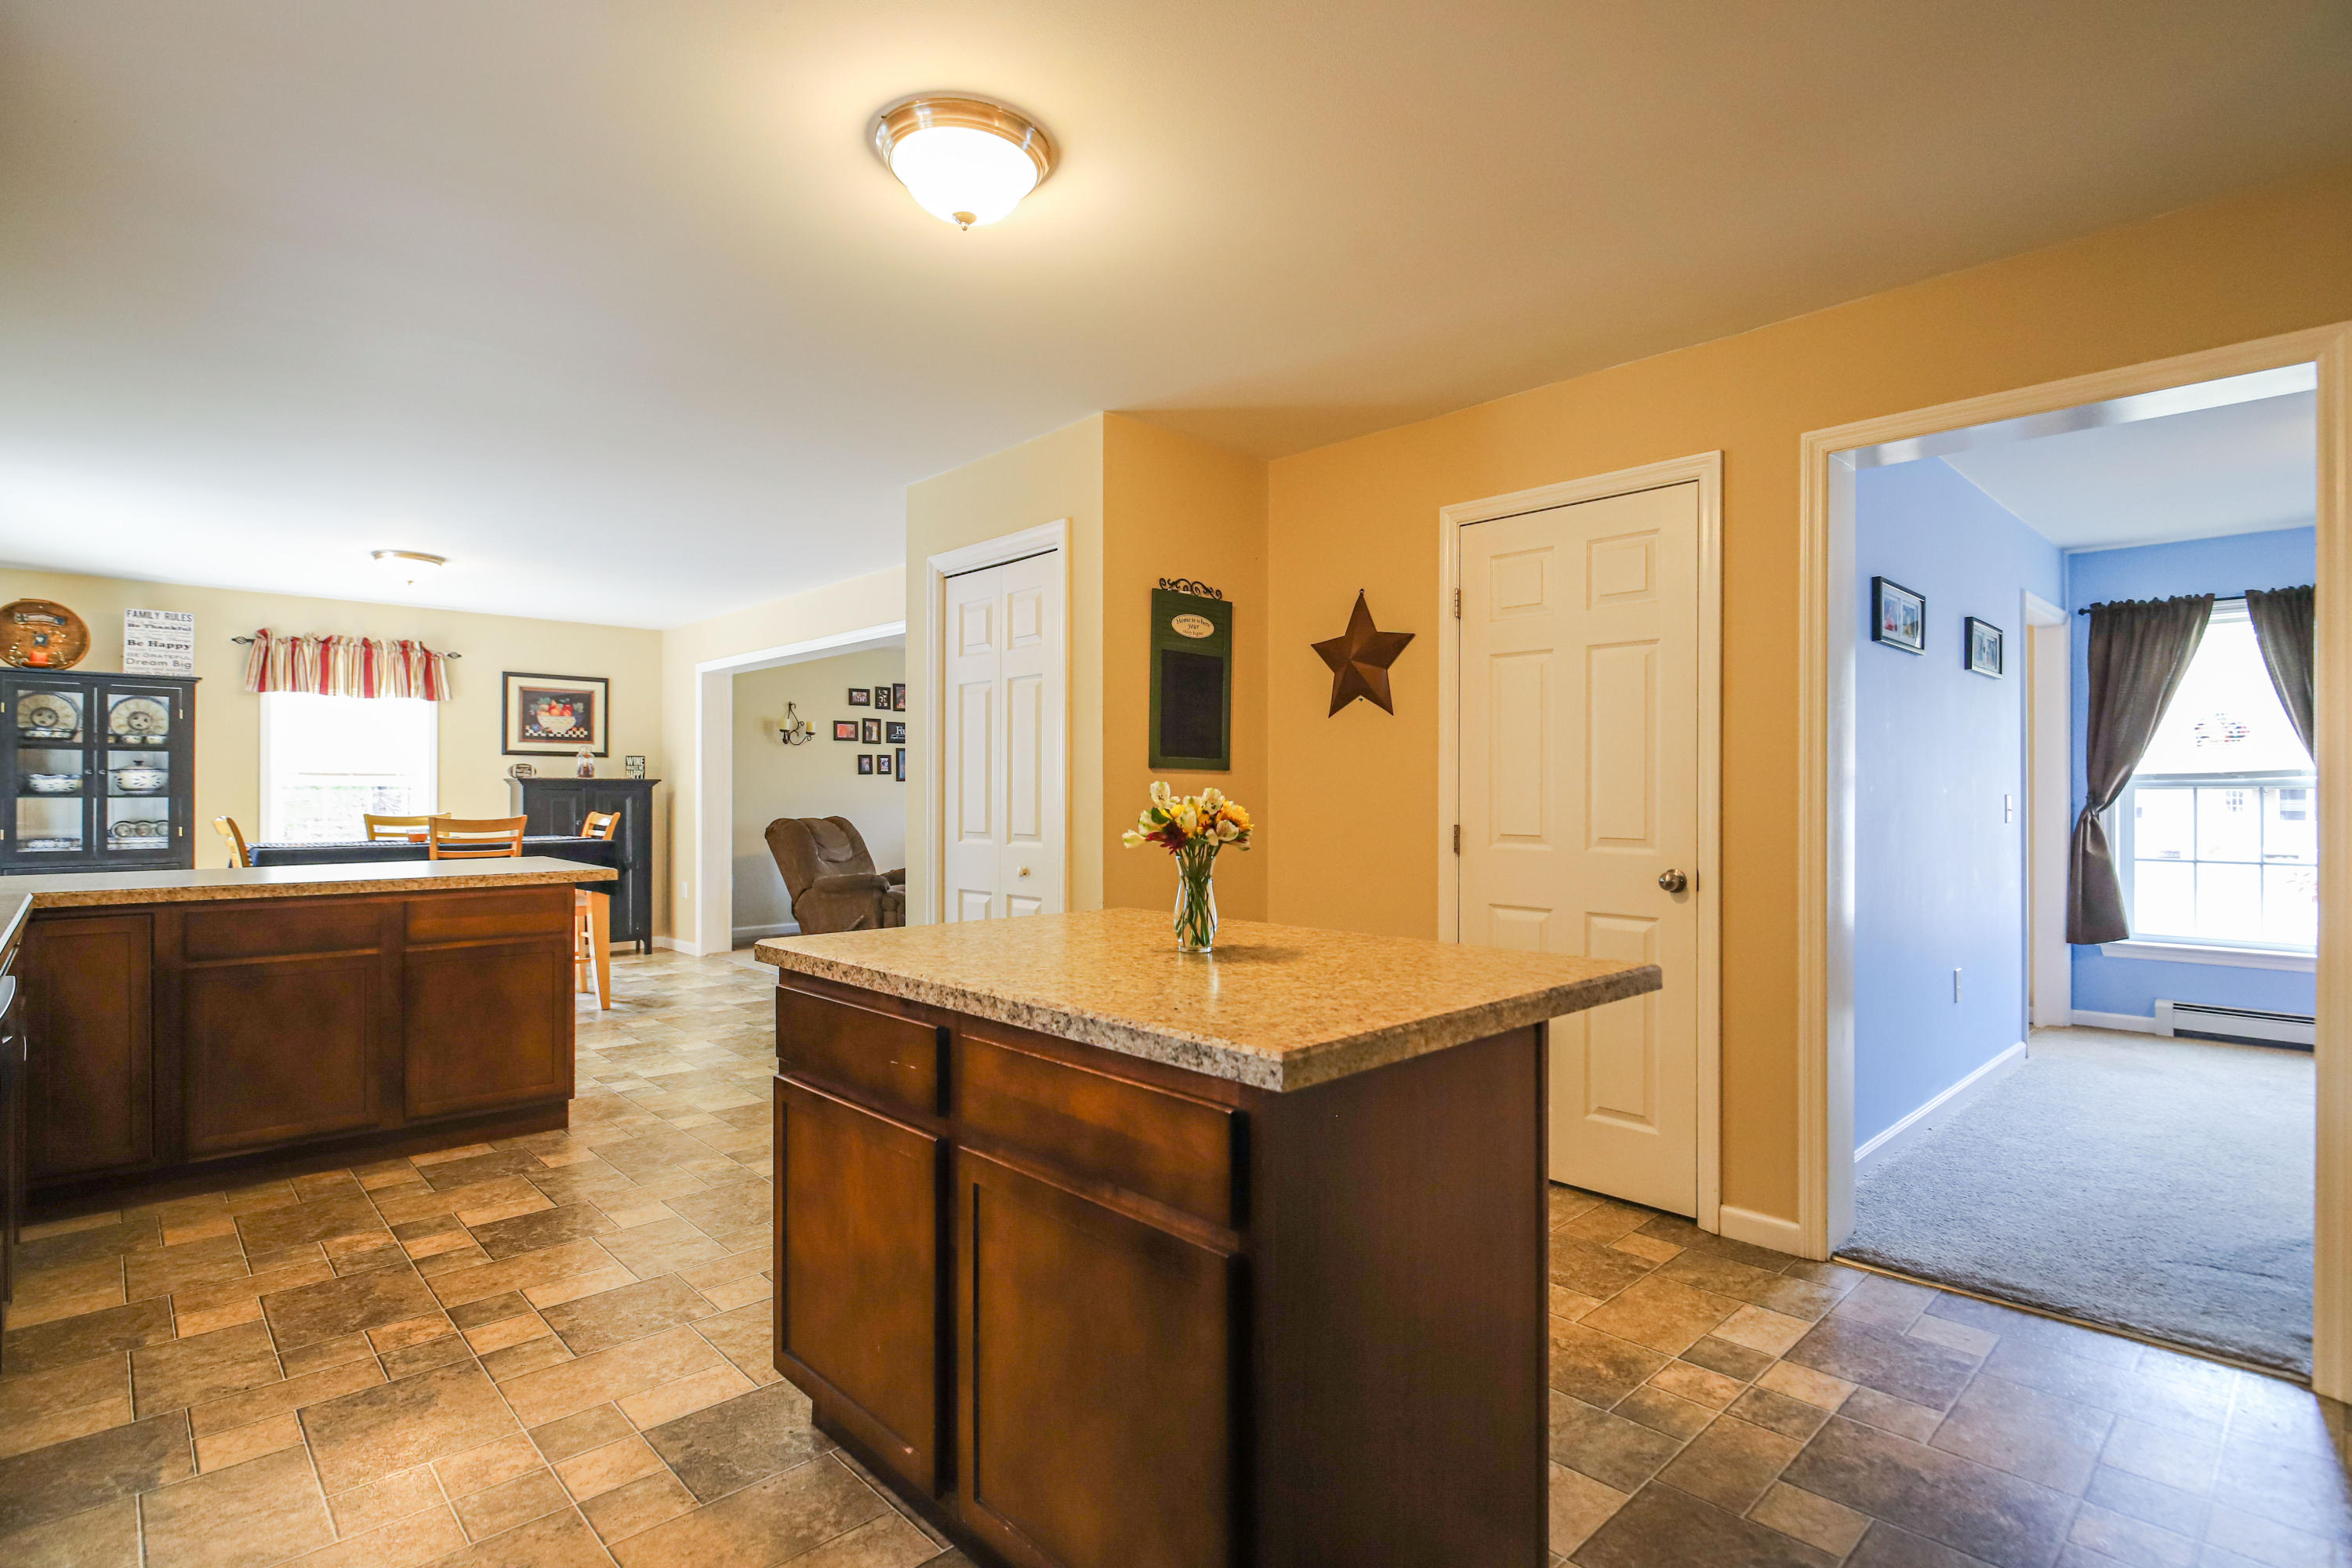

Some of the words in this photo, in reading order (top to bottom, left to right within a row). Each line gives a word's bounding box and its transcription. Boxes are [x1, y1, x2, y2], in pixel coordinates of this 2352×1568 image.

[126, 610, 160, 619] FAMILY
[165, 612, 193, 622] RULES
[1197, 619, 1210, 627] where
[149, 641, 191, 650] Happy
[173, 660, 191, 669] Big
[896, 726, 905, 735] Fa
[626, 757, 644, 765] WINE
[626, 770, 644, 779] HAPPY
